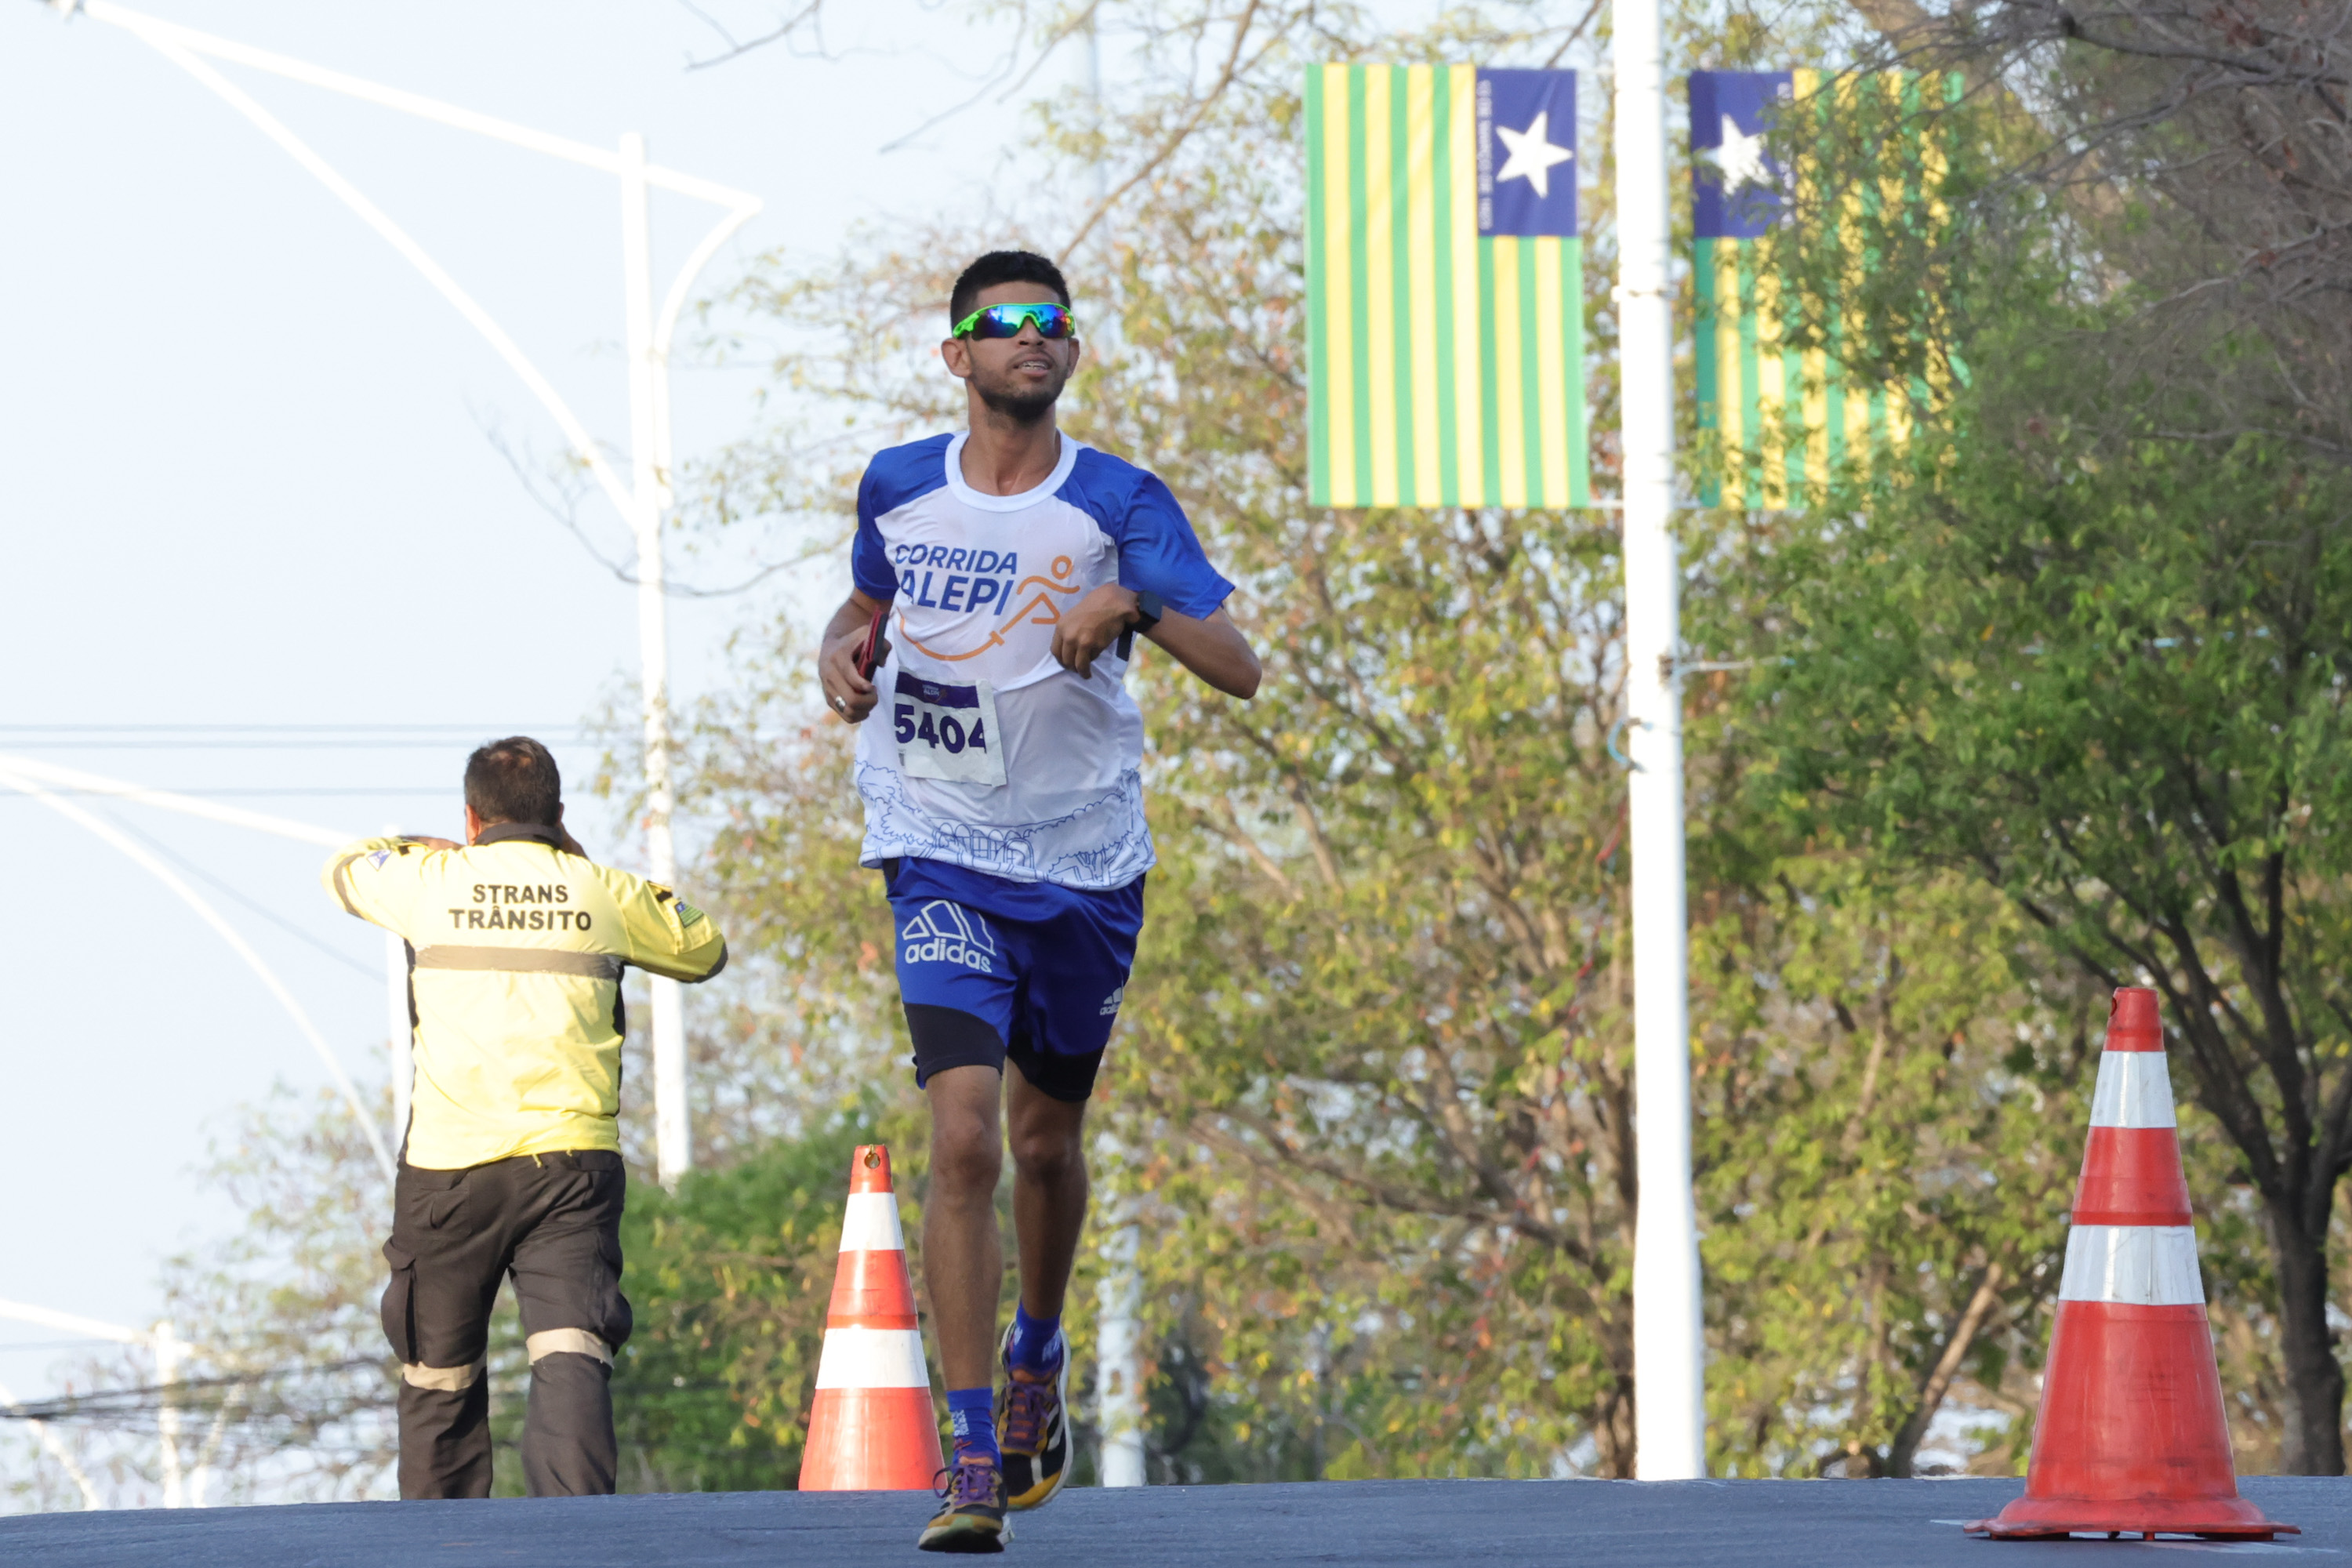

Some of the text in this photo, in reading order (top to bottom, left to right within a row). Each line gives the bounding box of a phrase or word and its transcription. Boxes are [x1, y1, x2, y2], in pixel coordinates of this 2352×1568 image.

[895, 544, 1018, 575] CORRIDA
[901, 569, 1014, 615] ALEPI
[894, 702, 987, 753] 5404
[472, 884, 569, 903] STRANS
[448, 906, 592, 931] TRÂNSITO
[905, 938, 993, 973] adidas
